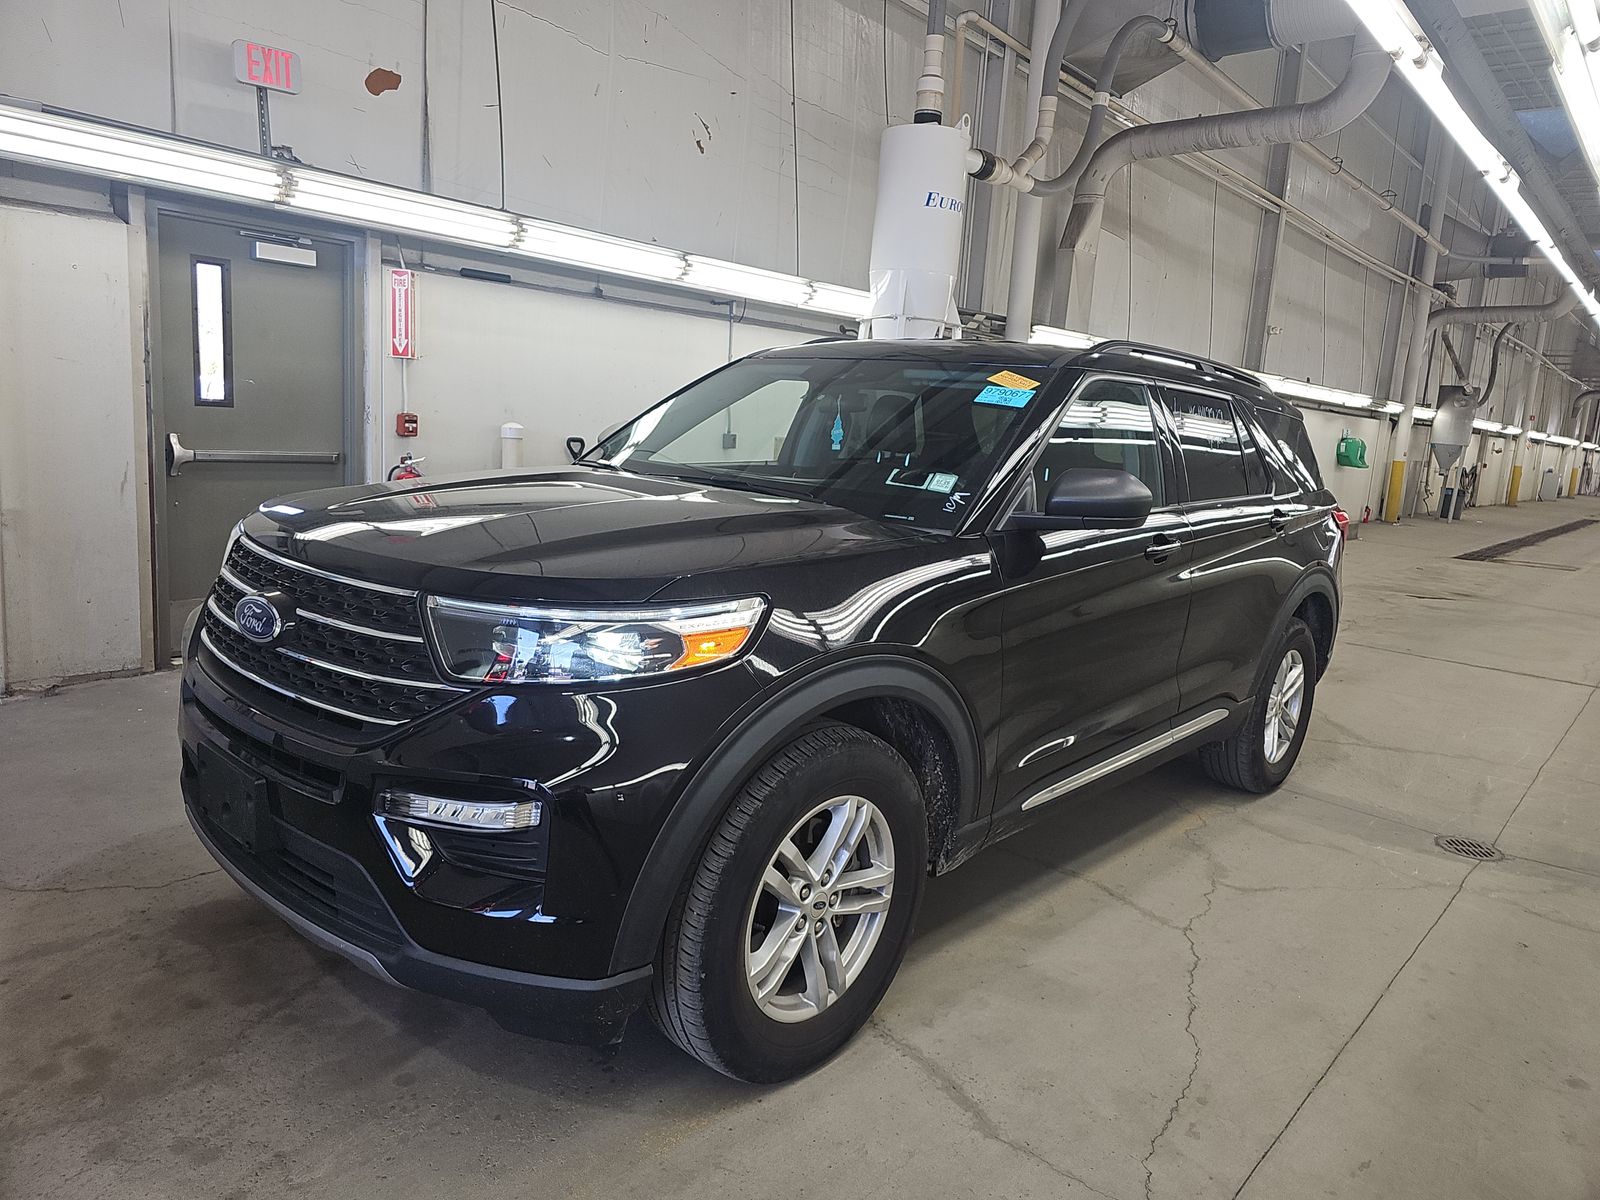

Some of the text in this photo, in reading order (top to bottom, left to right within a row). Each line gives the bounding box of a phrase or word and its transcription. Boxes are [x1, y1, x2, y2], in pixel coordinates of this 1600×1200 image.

[246, 43, 293, 89] EXIT
[393, 278, 407, 288] FIRE
[984, 387, 1034, 399] 9790677
[240, 603, 267, 633] Ford
